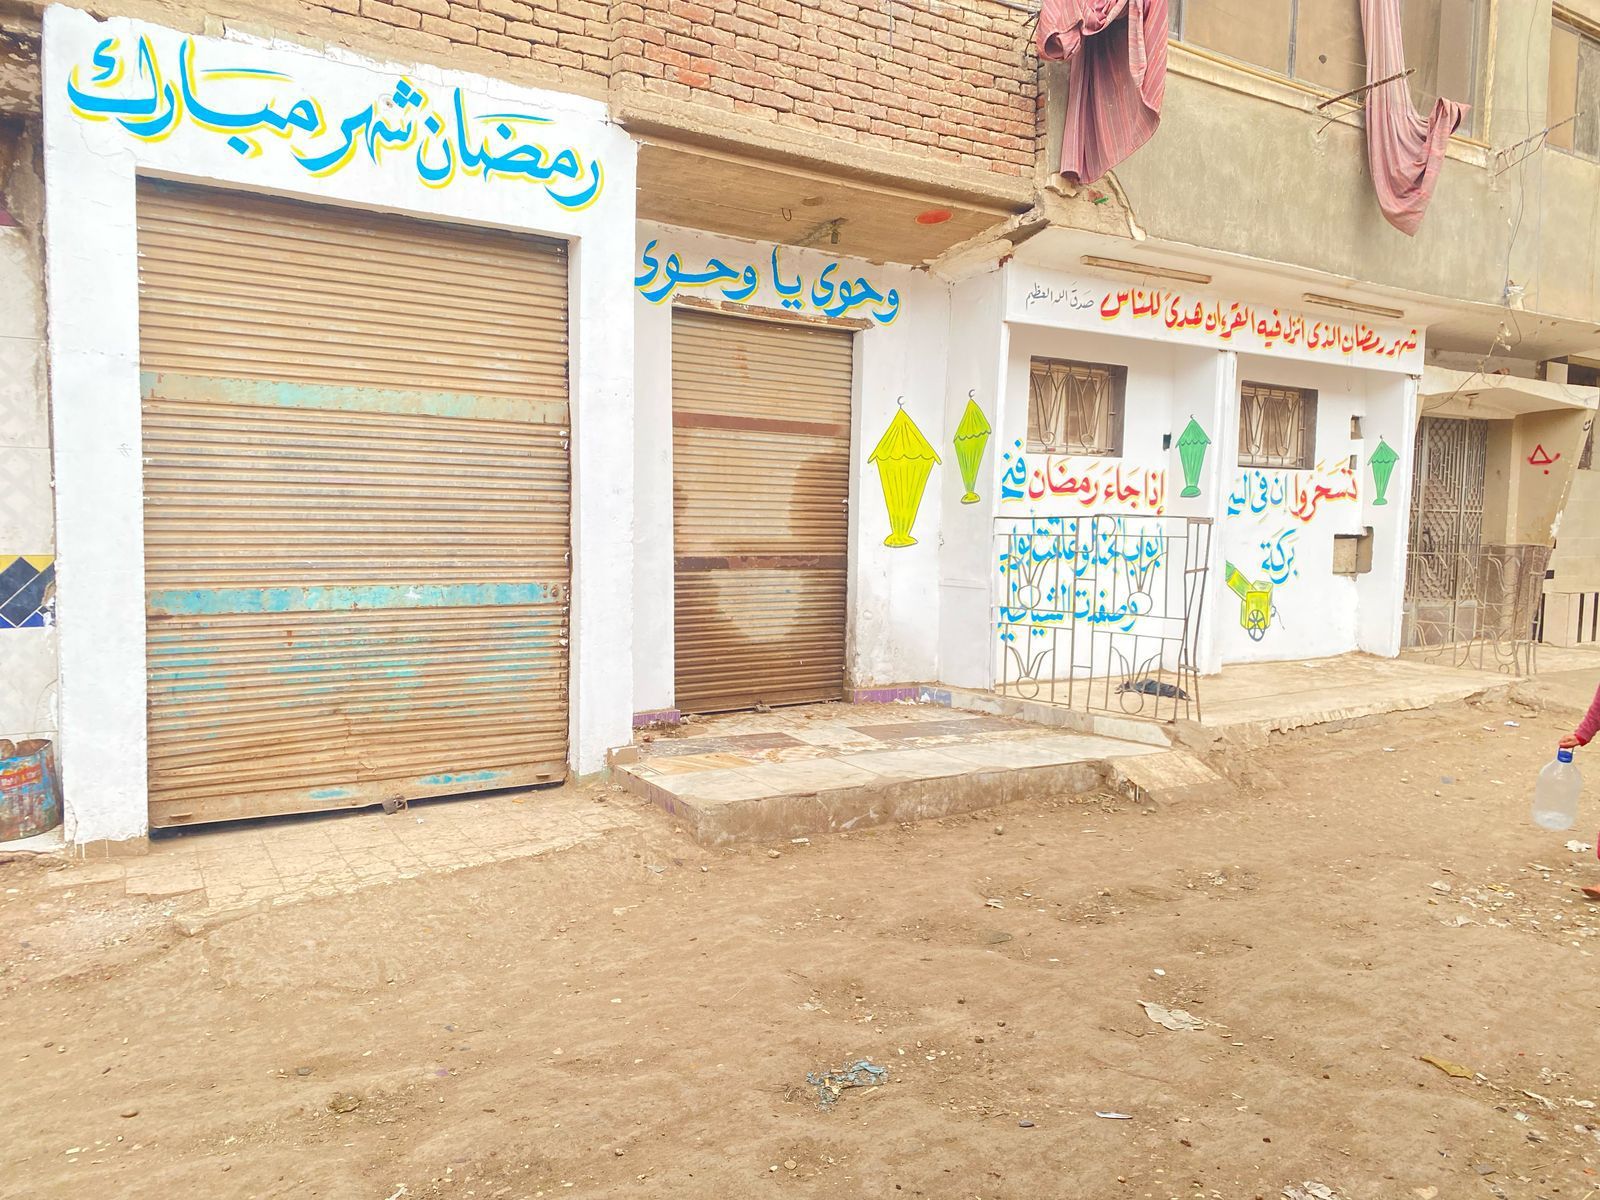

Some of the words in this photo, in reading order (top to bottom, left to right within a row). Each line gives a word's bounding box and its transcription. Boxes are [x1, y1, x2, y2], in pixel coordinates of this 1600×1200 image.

[293, 78, 424, 172] شهر
[771, 244, 804, 309] يا
[1025, 282, 1053, 310] العظيم
[1099, 286, 1162, 321] للناس
[1256, 308, 1283, 348] فيه
